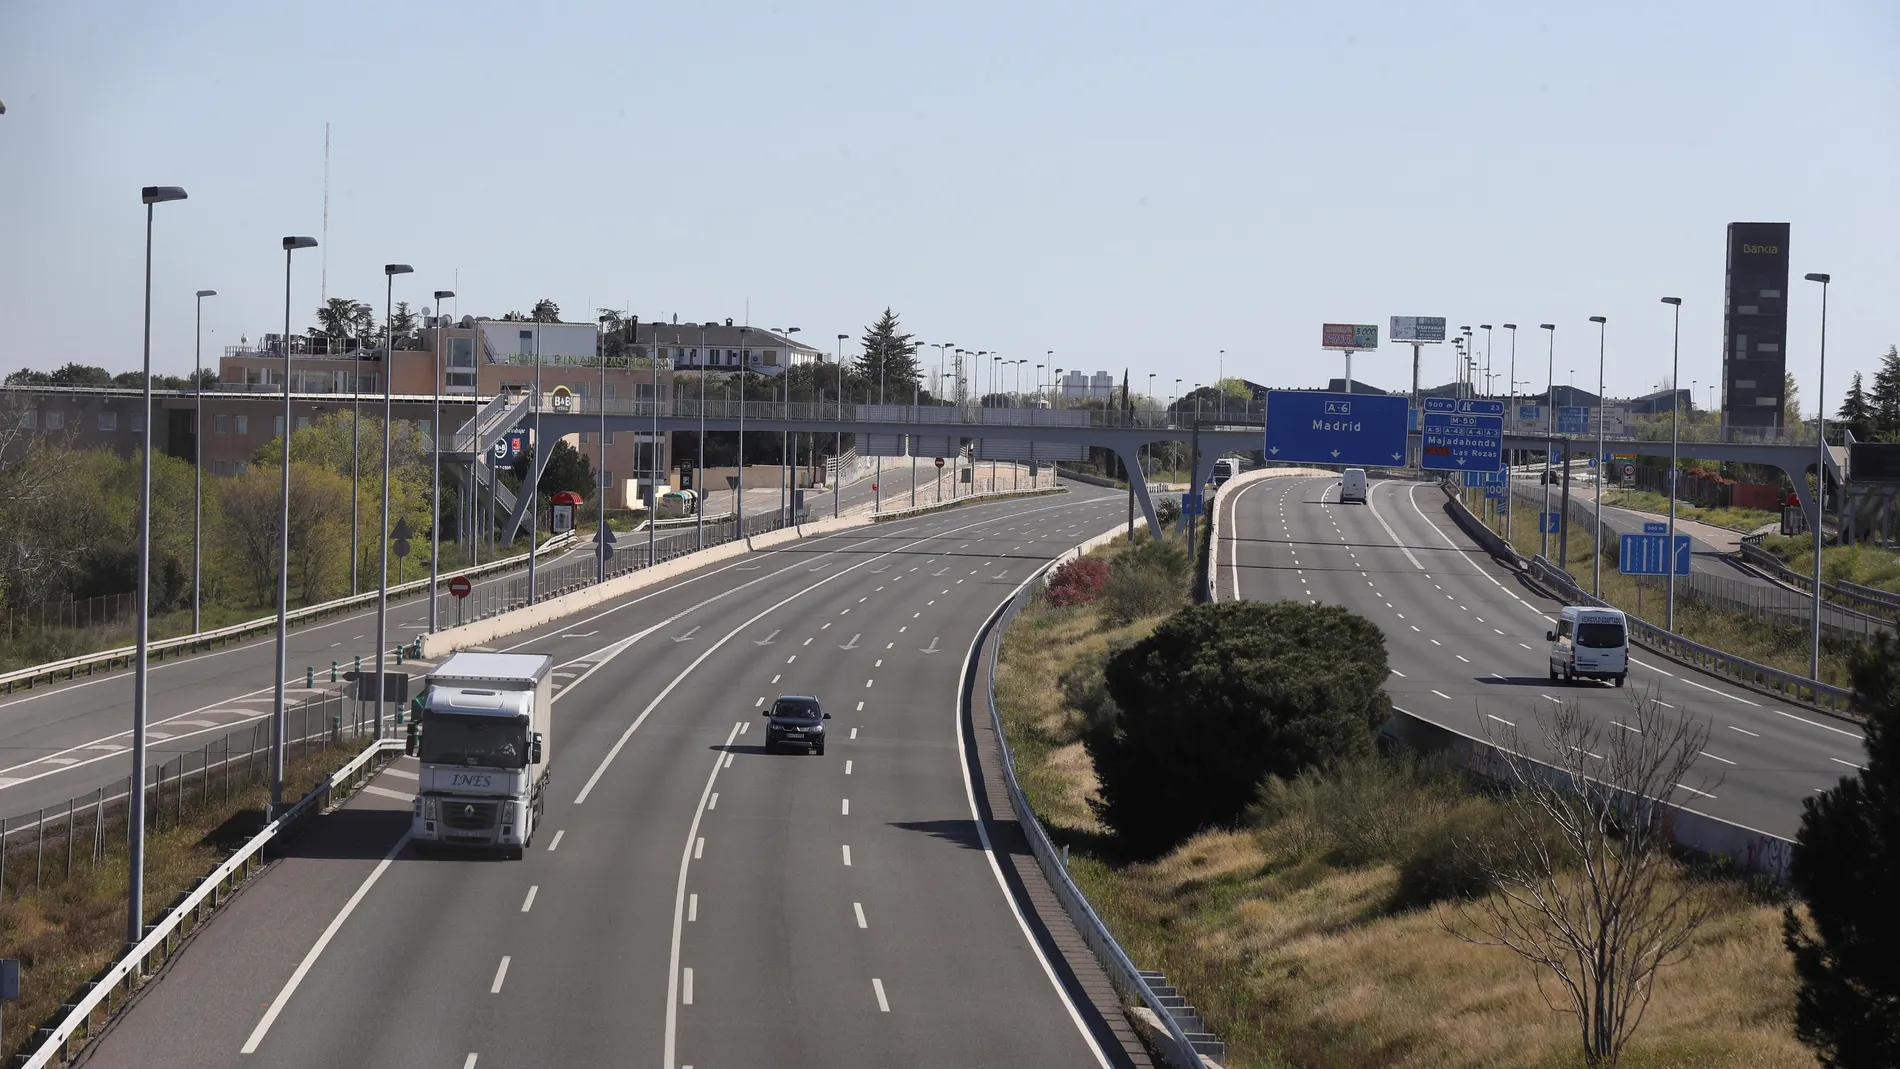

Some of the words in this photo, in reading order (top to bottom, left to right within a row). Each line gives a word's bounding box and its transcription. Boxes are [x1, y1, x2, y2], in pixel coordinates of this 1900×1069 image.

[1743, 243, 1778, 254] Bankia
[554, 396, 571, 406] B&B
[1327, 403, 1348, 413] A-6
[1312, 419, 1361, 432] Madrid
[1428, 436, 1496, 447] Majadahonda
[1453, 448, 1468, 456] Las
[1472, 450, 1497, 458] Rozas
[1486, 485, 1502, 494] 100
[452, 772, 492, 787] INÉS
